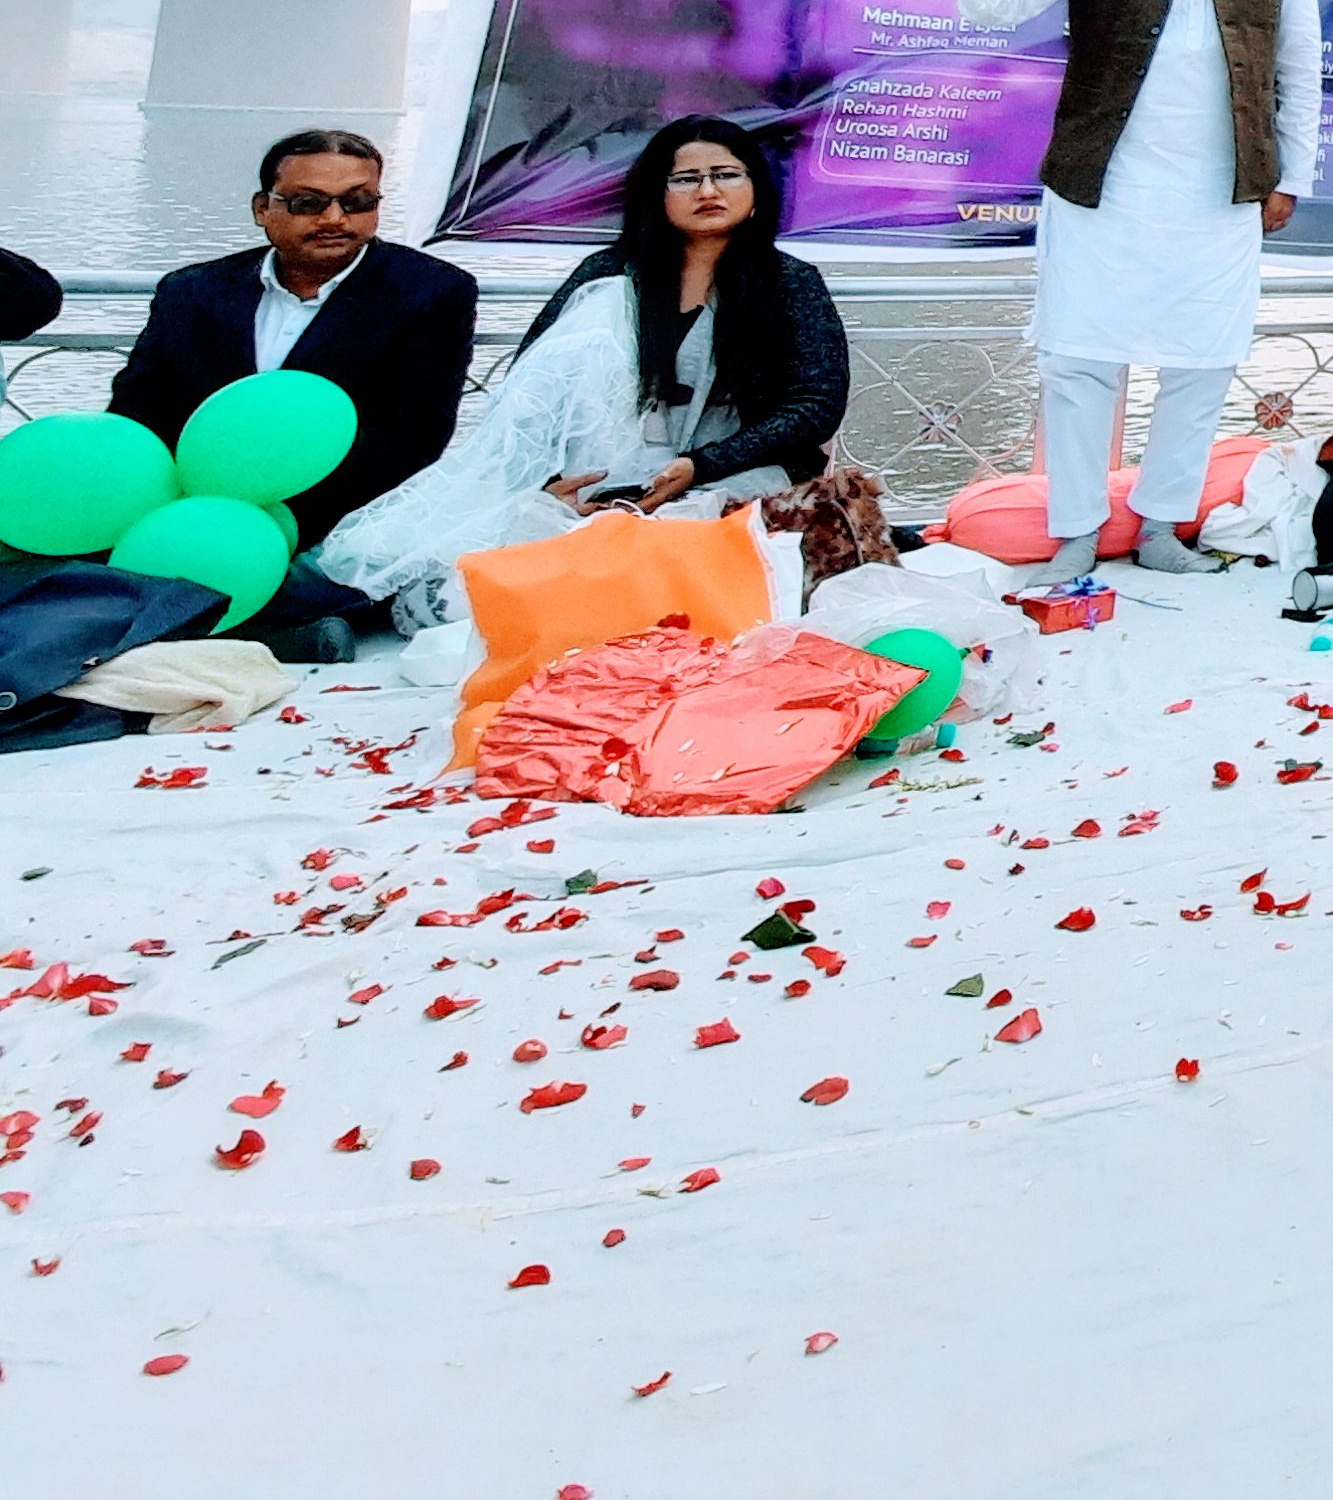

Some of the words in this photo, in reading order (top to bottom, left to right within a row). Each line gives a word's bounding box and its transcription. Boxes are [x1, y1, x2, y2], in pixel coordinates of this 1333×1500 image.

[863, 6, 953, 32] Mehmaan
[959, 16, 970, 32] E
[870, 31, 894, 47] Mr.
[938, 85, 1003, 101] Kaleem
[842, 99, 897, 117] Rehan
[903, 104, 968, 121] Hashmi
[834, 118, 898, 138] Uroosa
[901, 123, 949, 142] Arshi
[829, 140, 888, 161] Nizam
[893, 145, 970, 166] Banarasi
